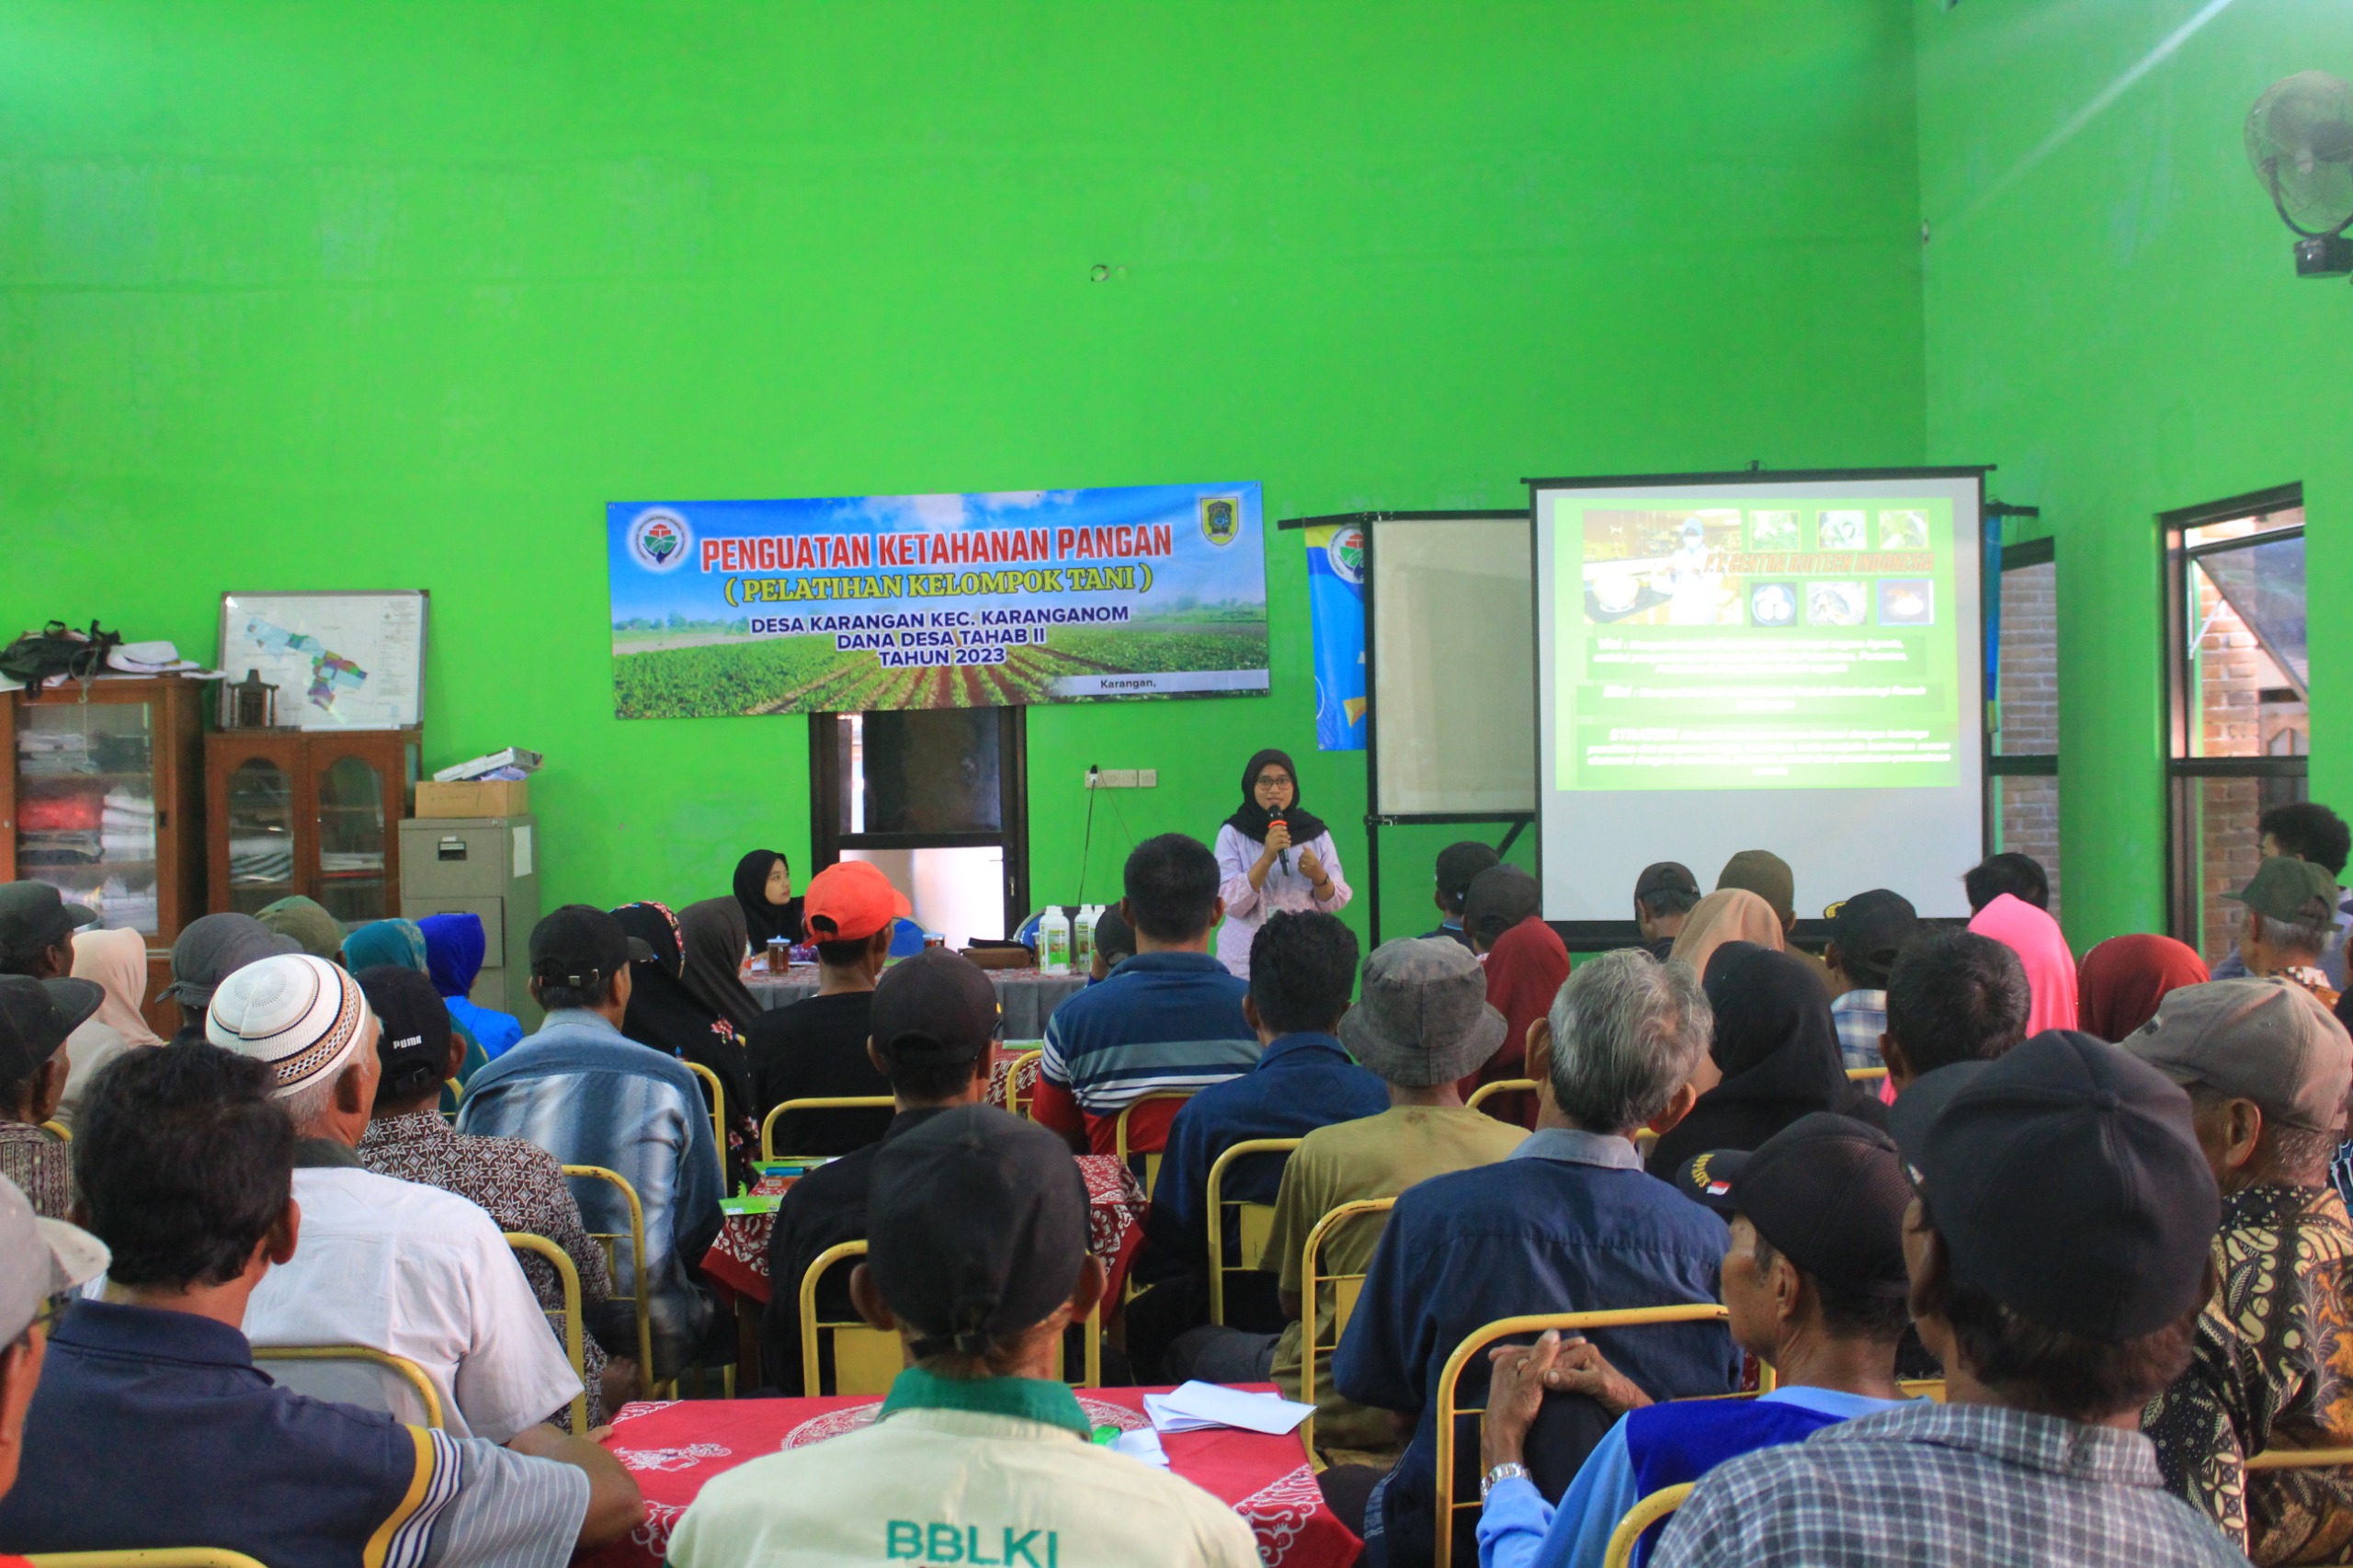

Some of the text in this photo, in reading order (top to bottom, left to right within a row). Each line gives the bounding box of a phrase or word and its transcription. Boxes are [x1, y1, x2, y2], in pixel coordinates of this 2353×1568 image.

[703, 536, 870, 572] PENGUATAN
[879, 529, 1049, 565] KETAHANAN
[1058, 525, 1172, 559] PANGAN
[1854, 551, 1935, 573] INDONESIA
[743, 575, 902, 602] PELATIHAN
[908, 568, 1063, 597] KELOMPOK
[1067, 565, 1134, 591] TANI
[752, 607, 1129, 633] DESA KARANGAN KEC. KARANGANOM
[837, 628, 1045, 649] DANA DESA TAHAB II
[880, 649, 1005, 667] TAHUN 2023
[393, 1035, 422, 1049] PUMA
[887, 1520, 1057, 1568] BBLKI
